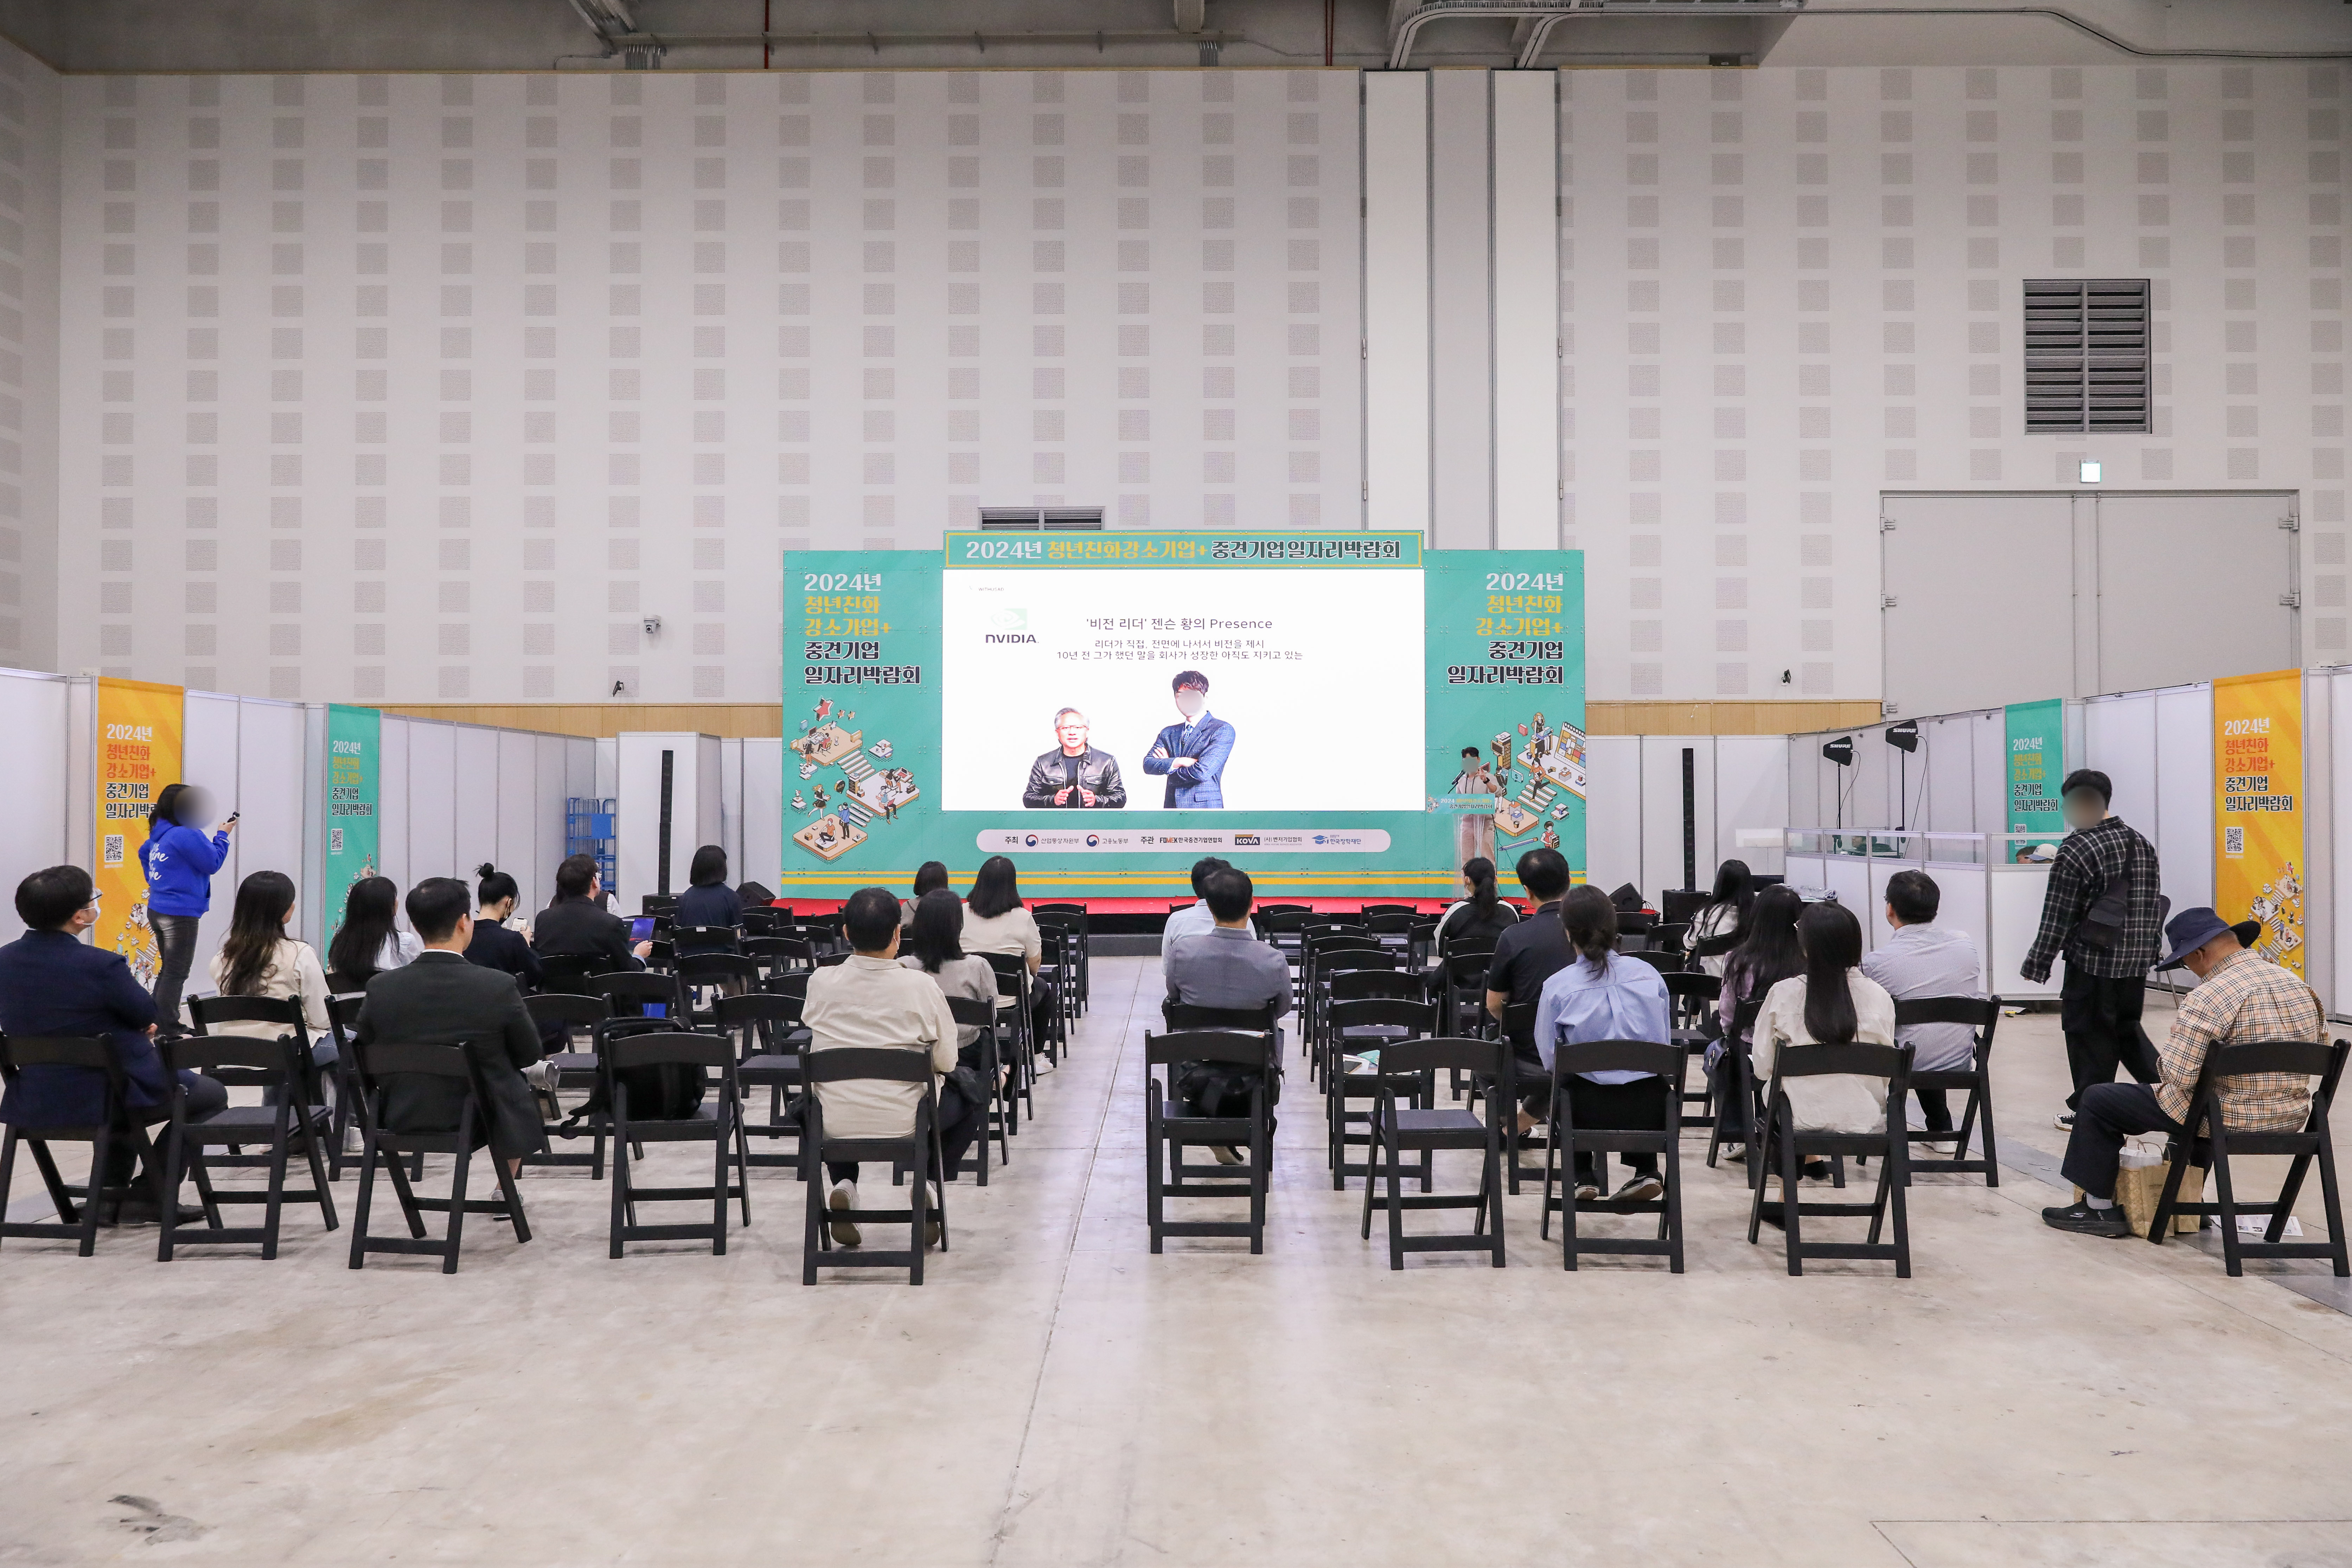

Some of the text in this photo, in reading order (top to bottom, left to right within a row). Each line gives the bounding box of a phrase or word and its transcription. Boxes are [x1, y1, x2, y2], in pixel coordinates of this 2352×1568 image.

[966, 541, 1041, 559] 2024년
[804, 574, 881, 591] 2024년
[1486, 573, 1563, 591] 2024년
[805, 596, 881, 614] 청년친화
[1487, 595, 1563, 613] 청년친화
[805, 618, 891, 636] 강소기업+
[1151, 618, 1176, 630] 젠슨
[1181, 618, 1204, 630] 황의
[1210, 619, 1272, 628] Presence
[1476, 618, 1563, 635] 강소기업+
[986, 634, 1036, 643] NVIDIA
[1095, 640, 1264, 649] 리더가 직접, 전면에 나서서 비전을 제시
[804, 641, 880, 660] 중견기업
[1057, 651, 1303, 660] 10년 전 그가 했던 말을 회사가 성장한 아직도 지키고 있는
[1489, 640, 1564, 660] 중견기업
[804, 665, 921, 685] 일자리박람회
[1447, 665, 1564, 684] 일자리박람회
[107, 723, 152, 742] 2024년
[2225, 718, 2270, 735] 2024년
[107, 743, 151, 761] 청년친화
[333, 741, 361, 754] 2024년
[2013, 737, 2042, 751] 2024년
[2225, 737, 2269, 755] 청년친화
[107, 763, 156, 779] 강소기업+
[106, 782, 149, 799] 중견기업
[2014, 783, 2042, 796] 중견기업
[2225, 775, 2268, 792] 중견기업
[332, 787, 359, 800] 중견기업
[106, 802, 157, 819] 일자리박
[332, 803, 372, 816] 일자리박람회
[2014, 799, 2058, 812] 일자리박람회
[2225, 795, 2293, 812] 일자리박람회
[1005, 836, 1018, 844] 주최
